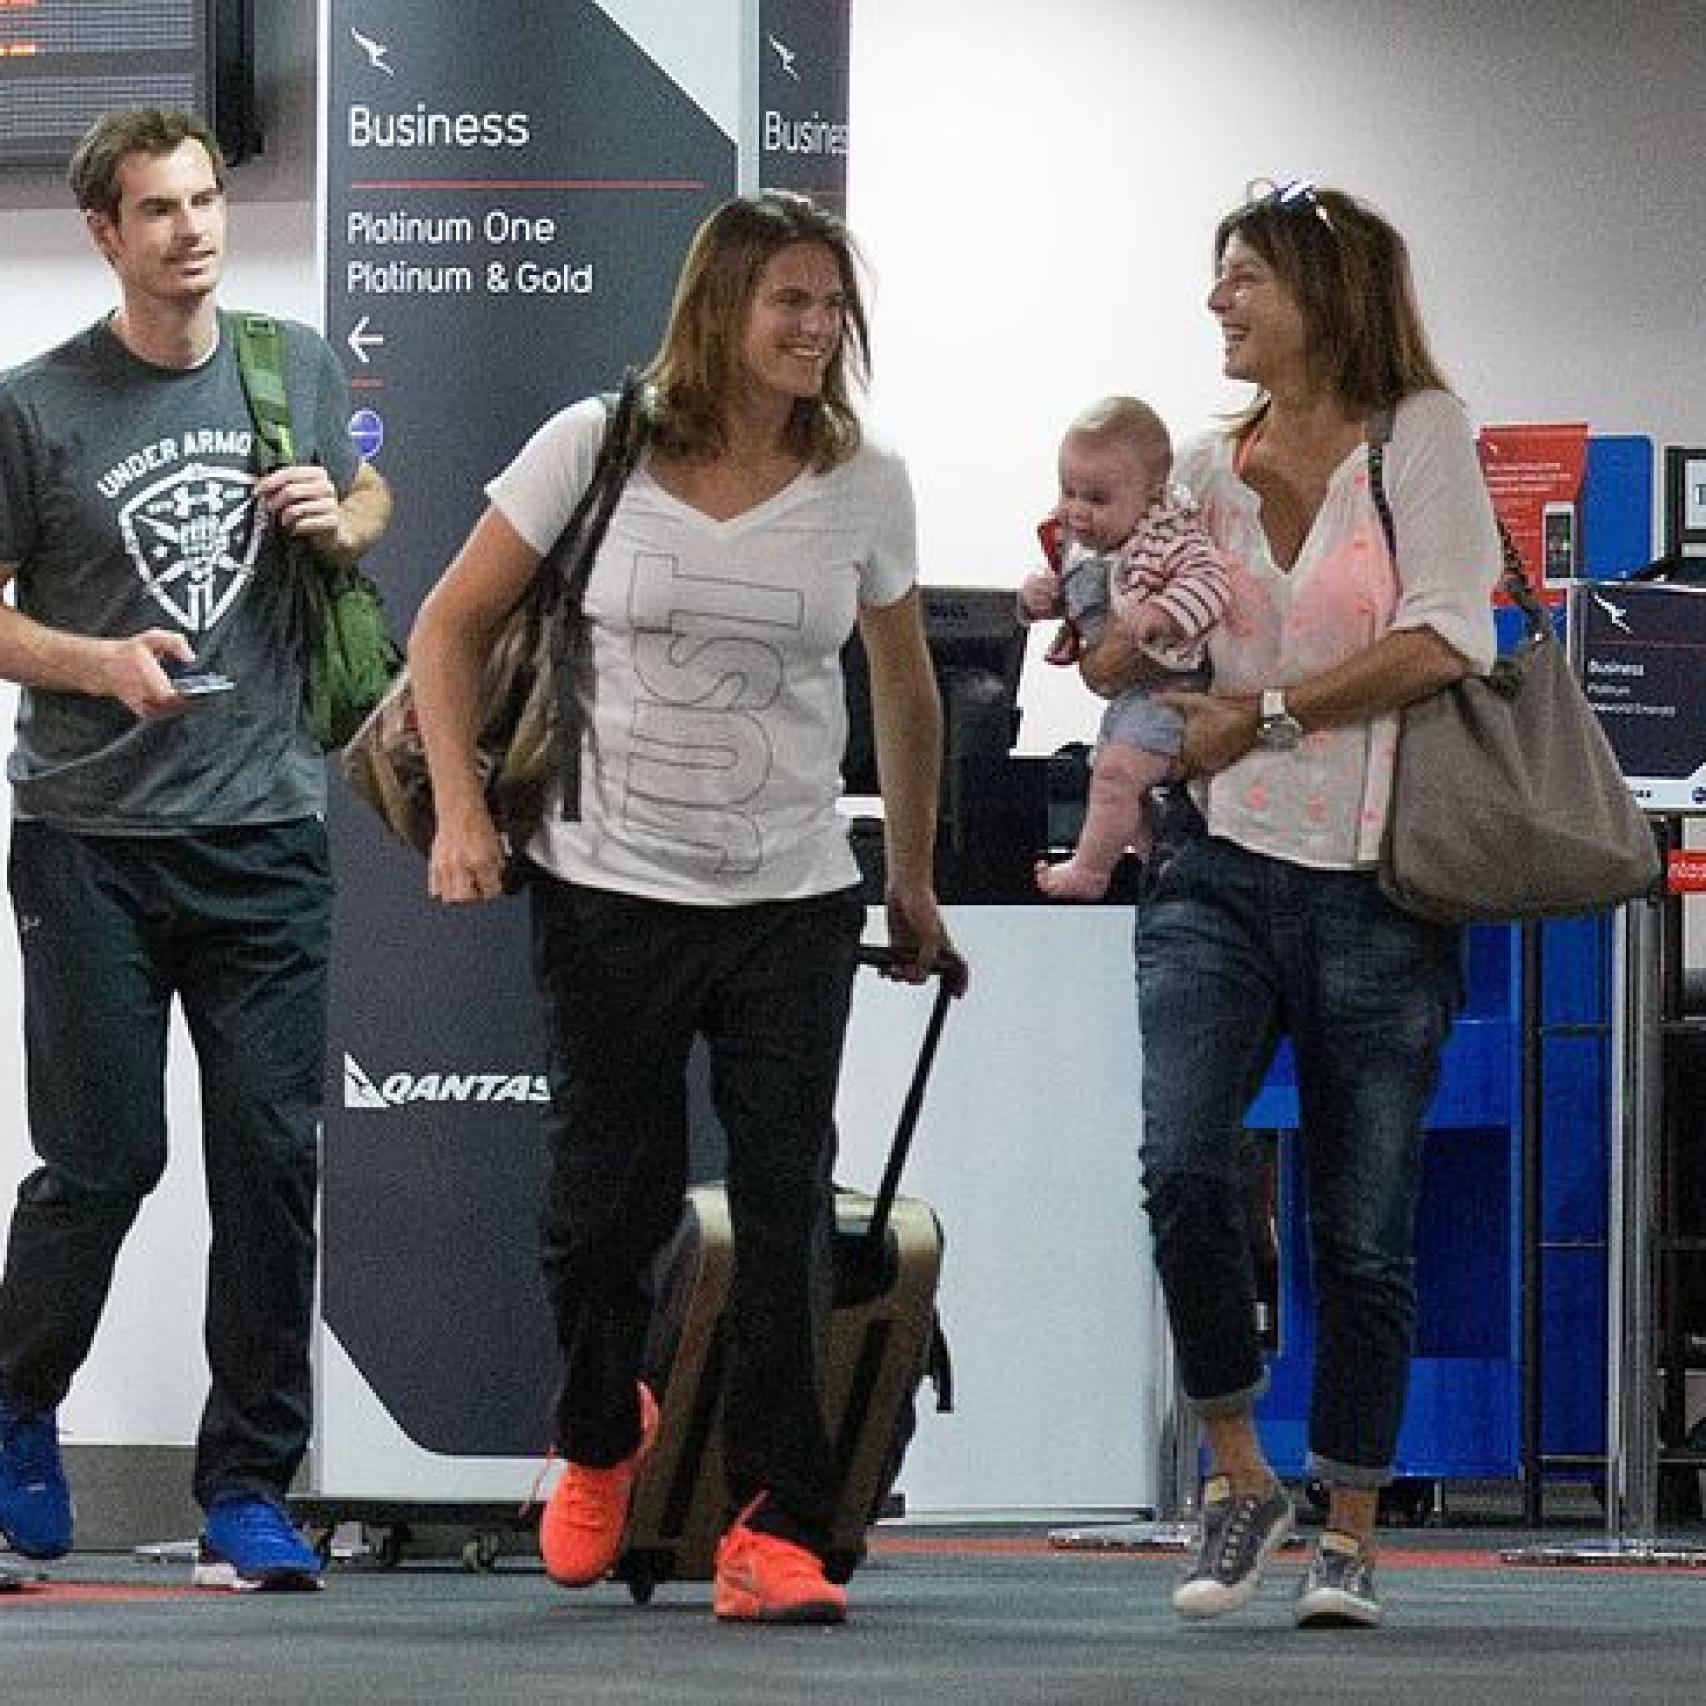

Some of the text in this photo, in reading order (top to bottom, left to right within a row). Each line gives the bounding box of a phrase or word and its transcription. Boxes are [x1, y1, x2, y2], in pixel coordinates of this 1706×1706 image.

[350, 103, 530, 147] Business
[347, 210, 556, 244] Platinum One
[347, 260, 593, 294] Platinum & Gold
[97, 428, 251, 498] UNDER ARMO
[382, 1072, 551, 1104] QANTAS
